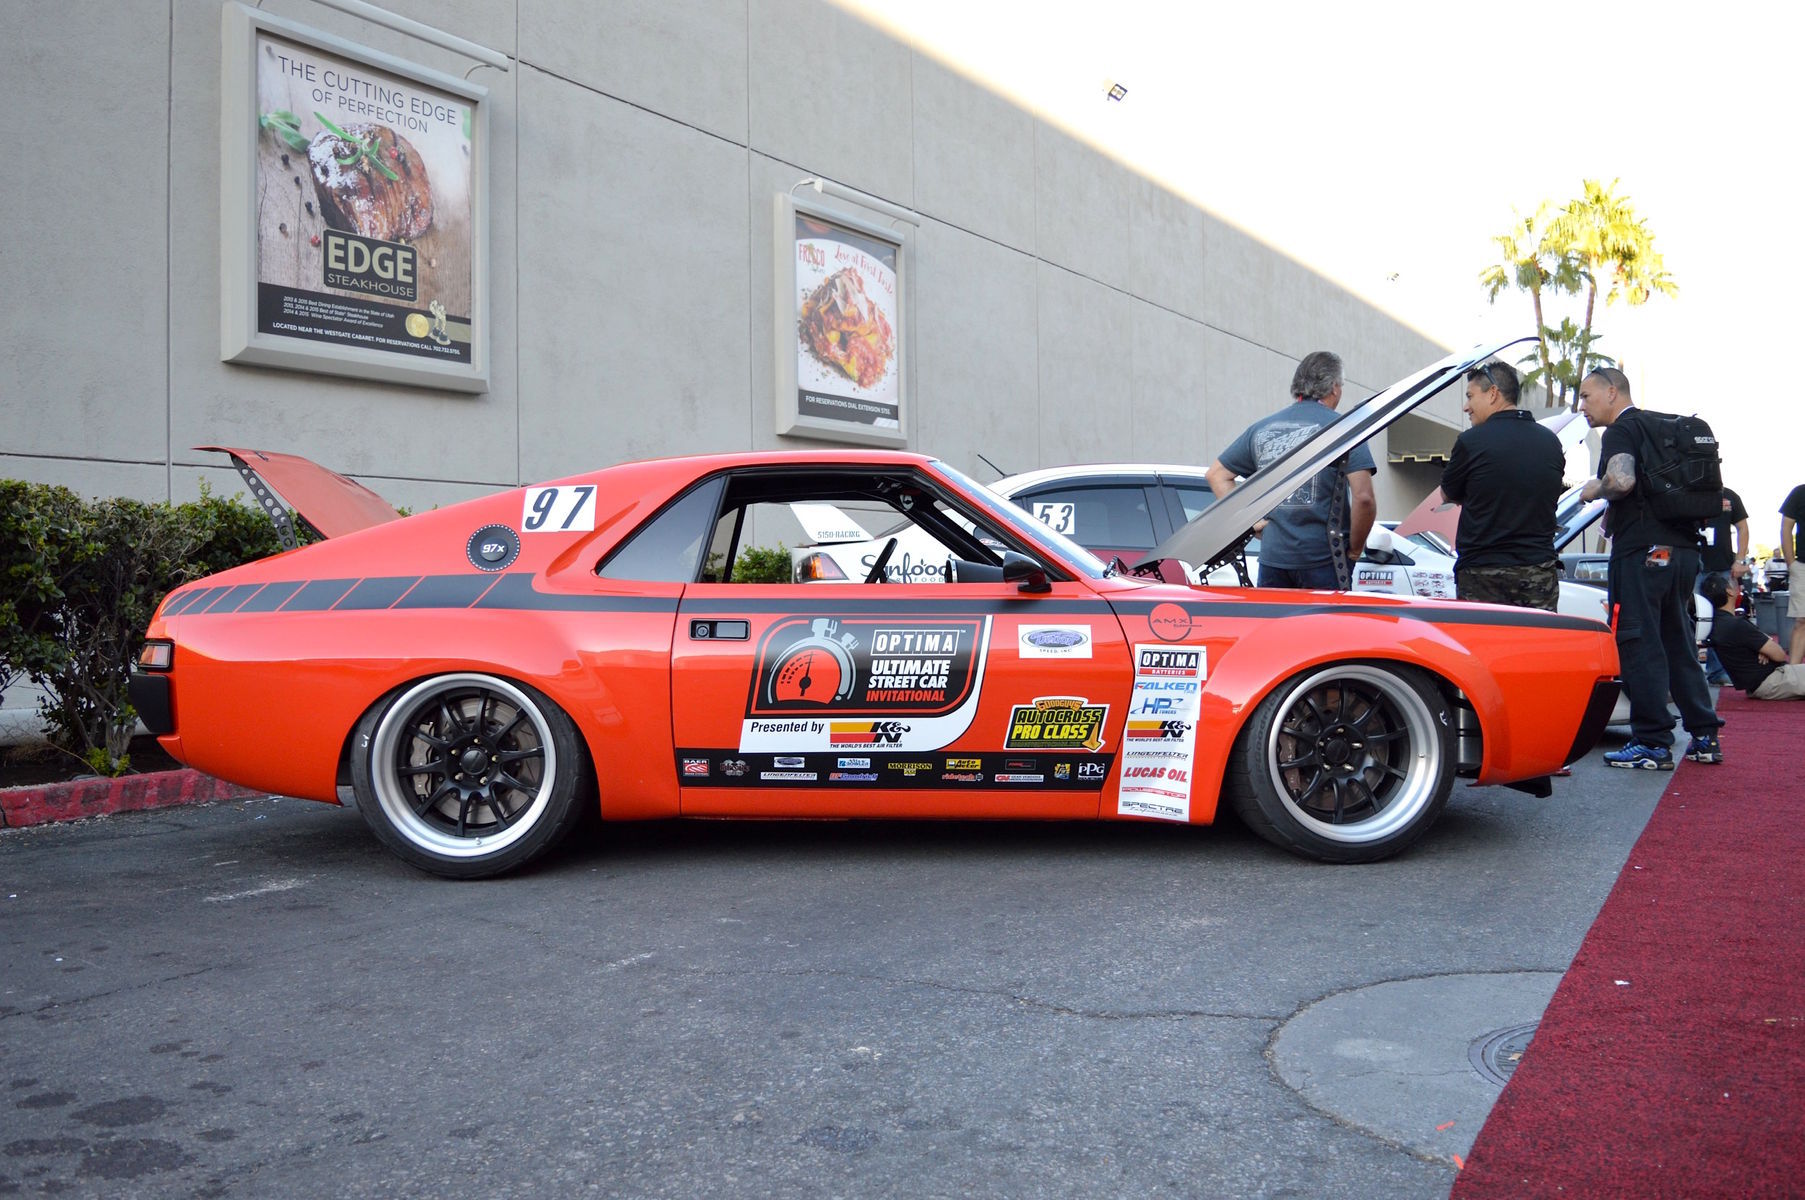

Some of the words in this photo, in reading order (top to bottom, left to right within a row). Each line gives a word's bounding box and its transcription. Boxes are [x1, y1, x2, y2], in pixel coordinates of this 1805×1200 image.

[278, 56, 316, 82] THE
[323, 71, 404, 109] CUTTING
[411, 97, 457, 125] EDGE
[312, 88, 333, 104] OF
[338, 95, 428, 134] PERFECTION
[328, 235, 413, 283] EDGE
[327, 273, 414, 298] STEAKHOUSE
[272, 322, 297, 331] LOCATED
[298, 325, 312, 333] NEAR
[324, 329, 351, 339] WESTGATE
[375, 336, 386, 344] FOR
[386, 338, 420, 349] RESERVATIONS
[420, 343, 432, 351] CALL
[806, 395, 816, 403] FOR
[816, 396, 848, 408] RESERVATIONS
[524, 486, 594, 530] 97
[1039, 504, 1073, 533] 53
[1360, 571, 1393, 580] OPTIMA
[876, 633, 954, 652] OPTIMA
[871, 659, 951, 675] ULTIMATE
[1142, 652, 1197, 667] OPTIMA
[868, 676, 919, 689] STREET
[919, 676, 948, 689] CAR
[1134, 682, 1198, 690] FALKEN
[866, 690, 945, 702] INVITATIONAL
[1035, 699, 1084, 712] GOODGUYS
[1142, 698, 1172, 714] HP
[1016, 709, 1102, 725] AUTOCROSS
[750, 721, 808, 733] Presented
[811, 721, 824, 735] by
[1011, 724, 1042, 740] PRO
[1043, 724, 1090, 740] CLASS
[888, 762, 932, 770] MORRISON
[1078, 762, 1106, 775] PPG
[1124, 767, 1166, 778] LUCAS
[1168, 768, 1188, 782] OIL
[1122, 801, 1184, 815] SPECTRE
